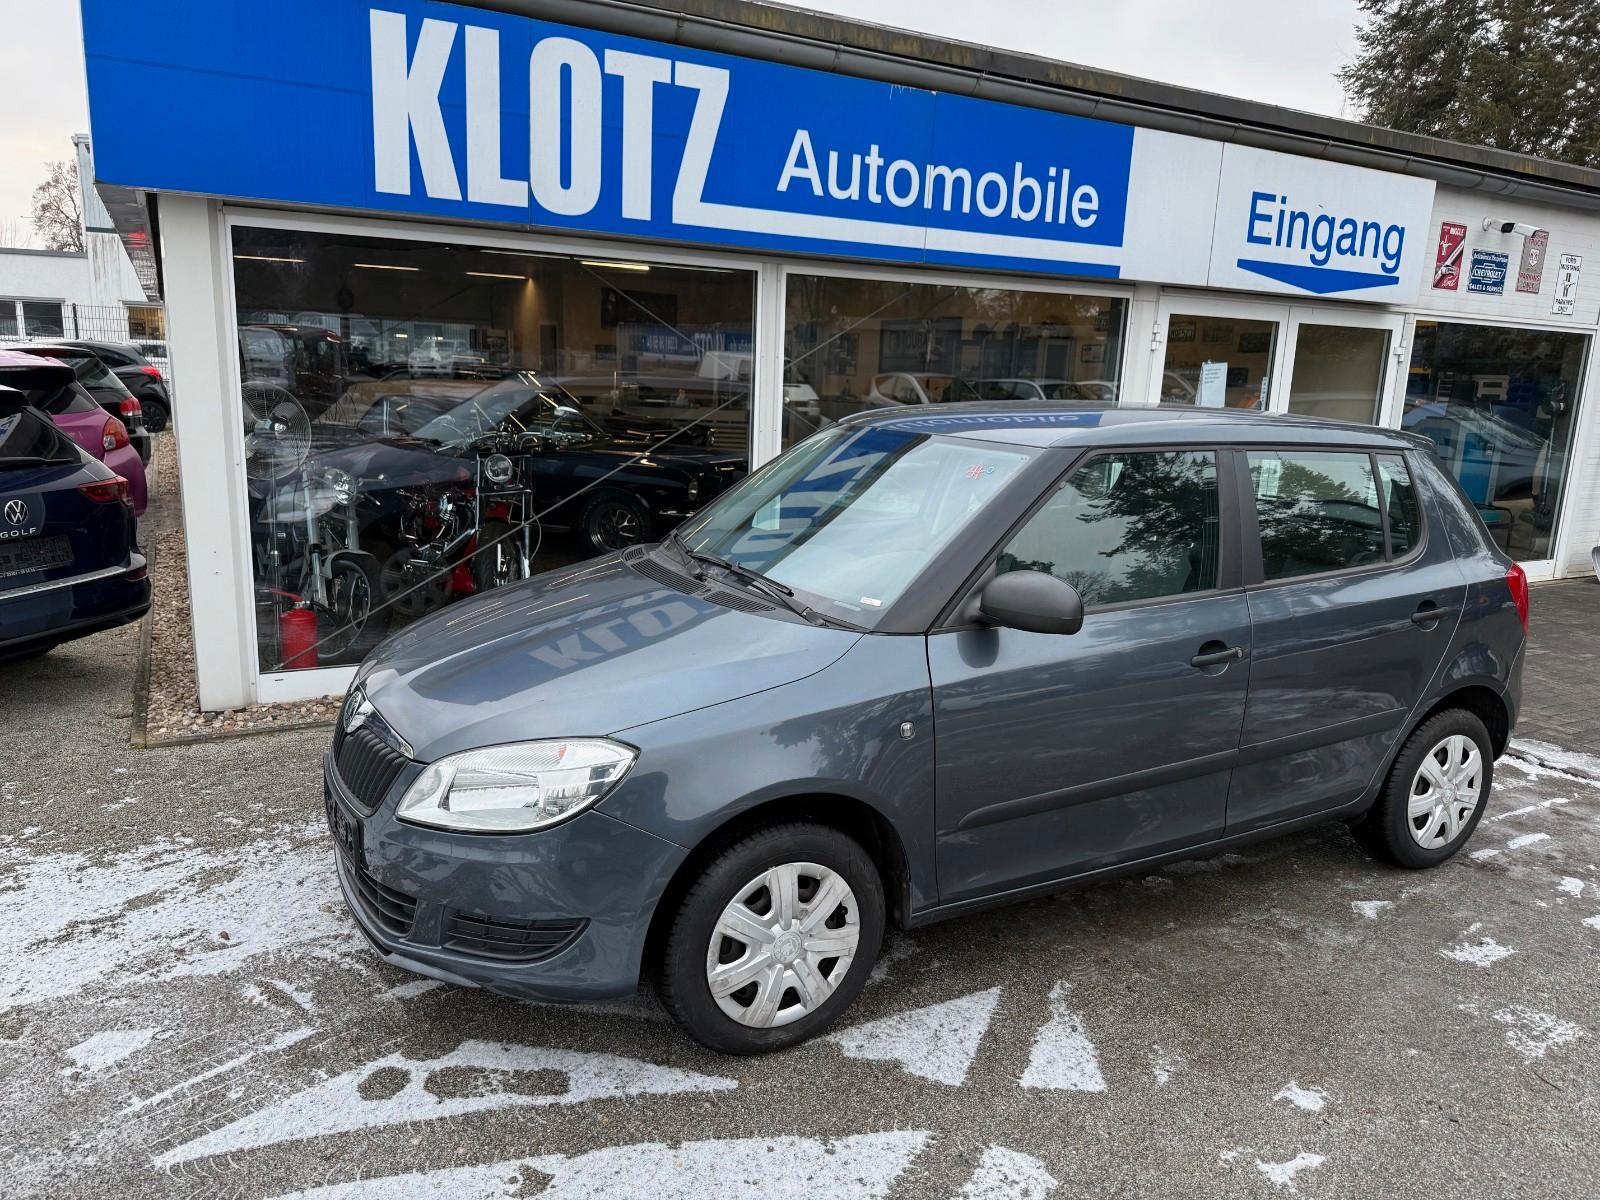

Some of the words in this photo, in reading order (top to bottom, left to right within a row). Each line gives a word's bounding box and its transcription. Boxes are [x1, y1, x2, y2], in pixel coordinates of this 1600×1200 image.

[370, 8, 730, 227] KLOTZ
[776, 128, 1099, 228] Automobile
[1247, 191, 1405, 274] Eingang
[0, 527, 37, 539] GOLF
